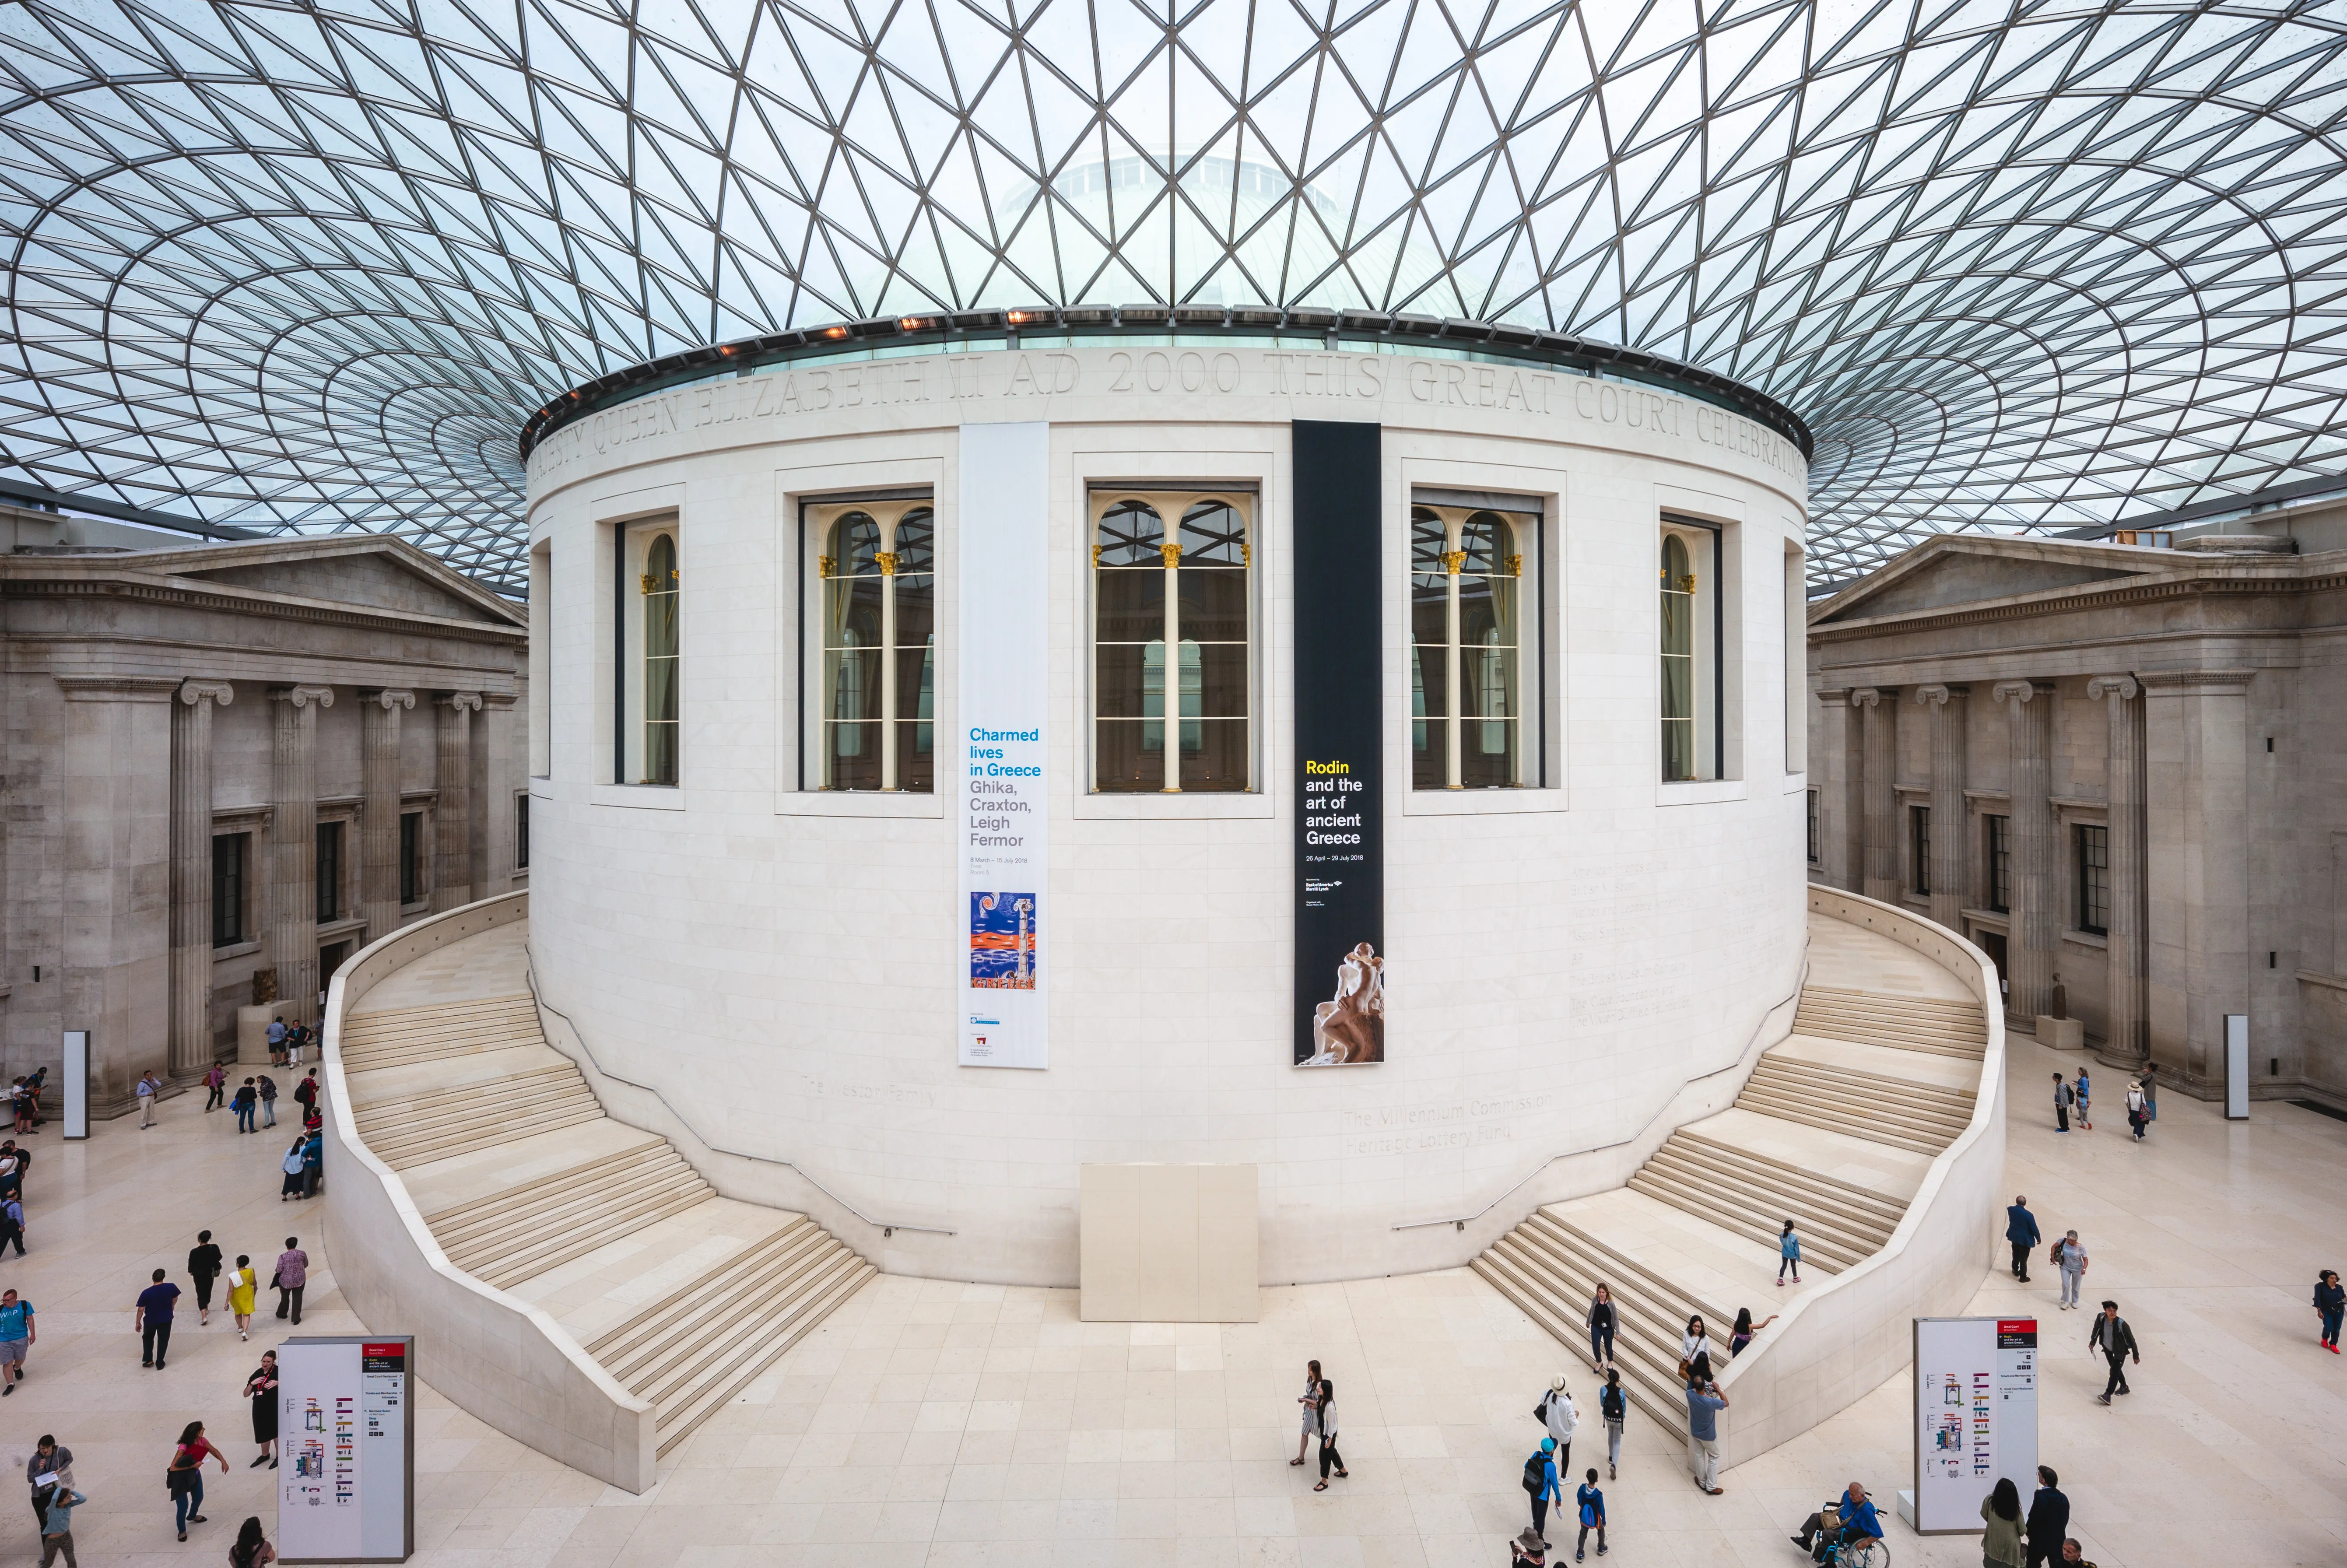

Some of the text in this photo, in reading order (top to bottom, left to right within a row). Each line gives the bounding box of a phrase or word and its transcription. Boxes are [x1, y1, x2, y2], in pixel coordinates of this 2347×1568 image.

[593, 394, 682, 455] QUEEN
[695, 360, 930, 428] ELIZABETH
[950, 357, 984, 398] II
[1003, 354, 1081, 396] AD
[1108, 351, 1241, 393] 2000
[1263, 353, 1382, 398] THIS
[1408, 361, 1556, 415] GREAT
[1575, 380, 1684, 436] COURT
[1696, 407, 1802, 484] CELEBRATING
[970, 728, 1038, 741] Charmed
[970, 746, 1003, 758] lives
[970, 763, 1041, 776] in Greece
[1307, 761, 1349, 774] Rodin
[970, 781, 1017, 795] Ghika,
[1306, 779, 1362, 791] and the
[970, 798, 1031, 813] Craxton,
[1306, 796, 1346, 809] art of
[971, 816, 1010, 831] Leigh
[1306, 814, 1361, 827] ancient
[971, 834, 1023, 846] Fermor
[1306, 831, 1360, 845] Greece
[974, 978, 1035, 989] GREECE
[801, 1075, 937, 1108] The Weston Family
[1344, 1093, 1552, 1127] The Millennium Commission
[1346, 1122, 1511, 1154] Heritage Lottery Fund
